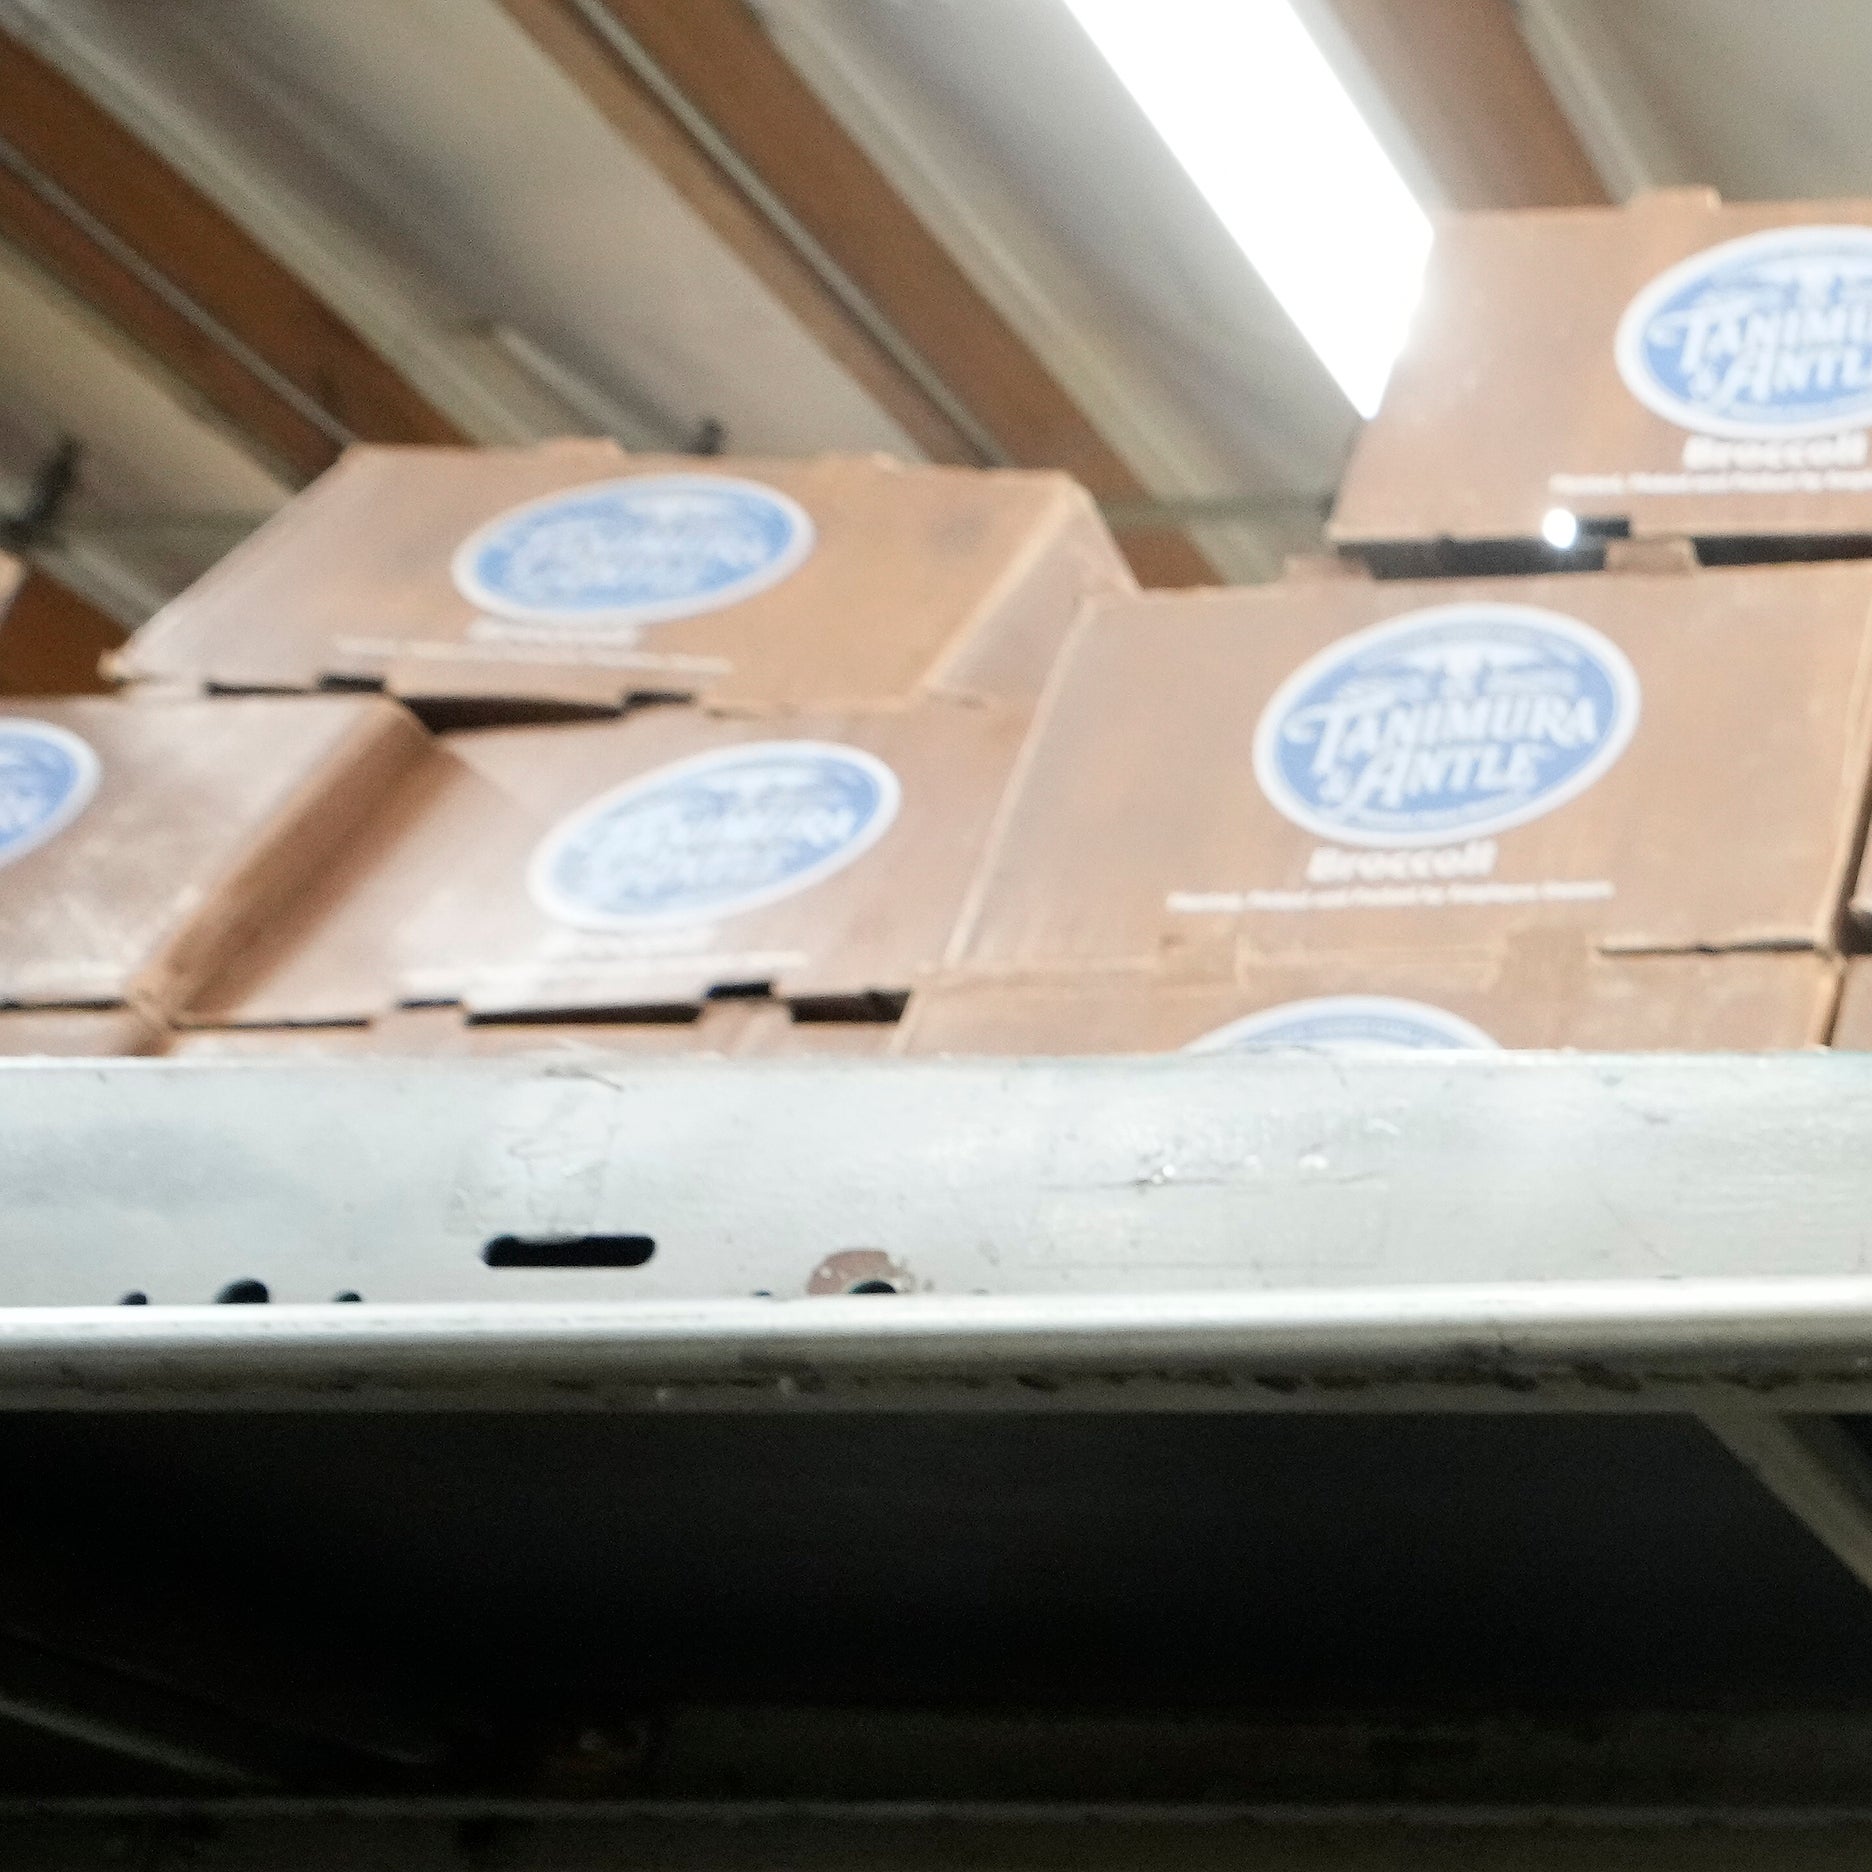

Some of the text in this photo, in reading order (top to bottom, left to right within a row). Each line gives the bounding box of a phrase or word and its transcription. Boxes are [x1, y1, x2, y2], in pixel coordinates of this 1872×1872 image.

[1682, 430, 1869, 470] Broccoli
[1282, 690, 1599, 776] TANIMURA
[1338, 738, 1550, 822] ANTLE
[1306, 838, 1498, 882] Broccoli
